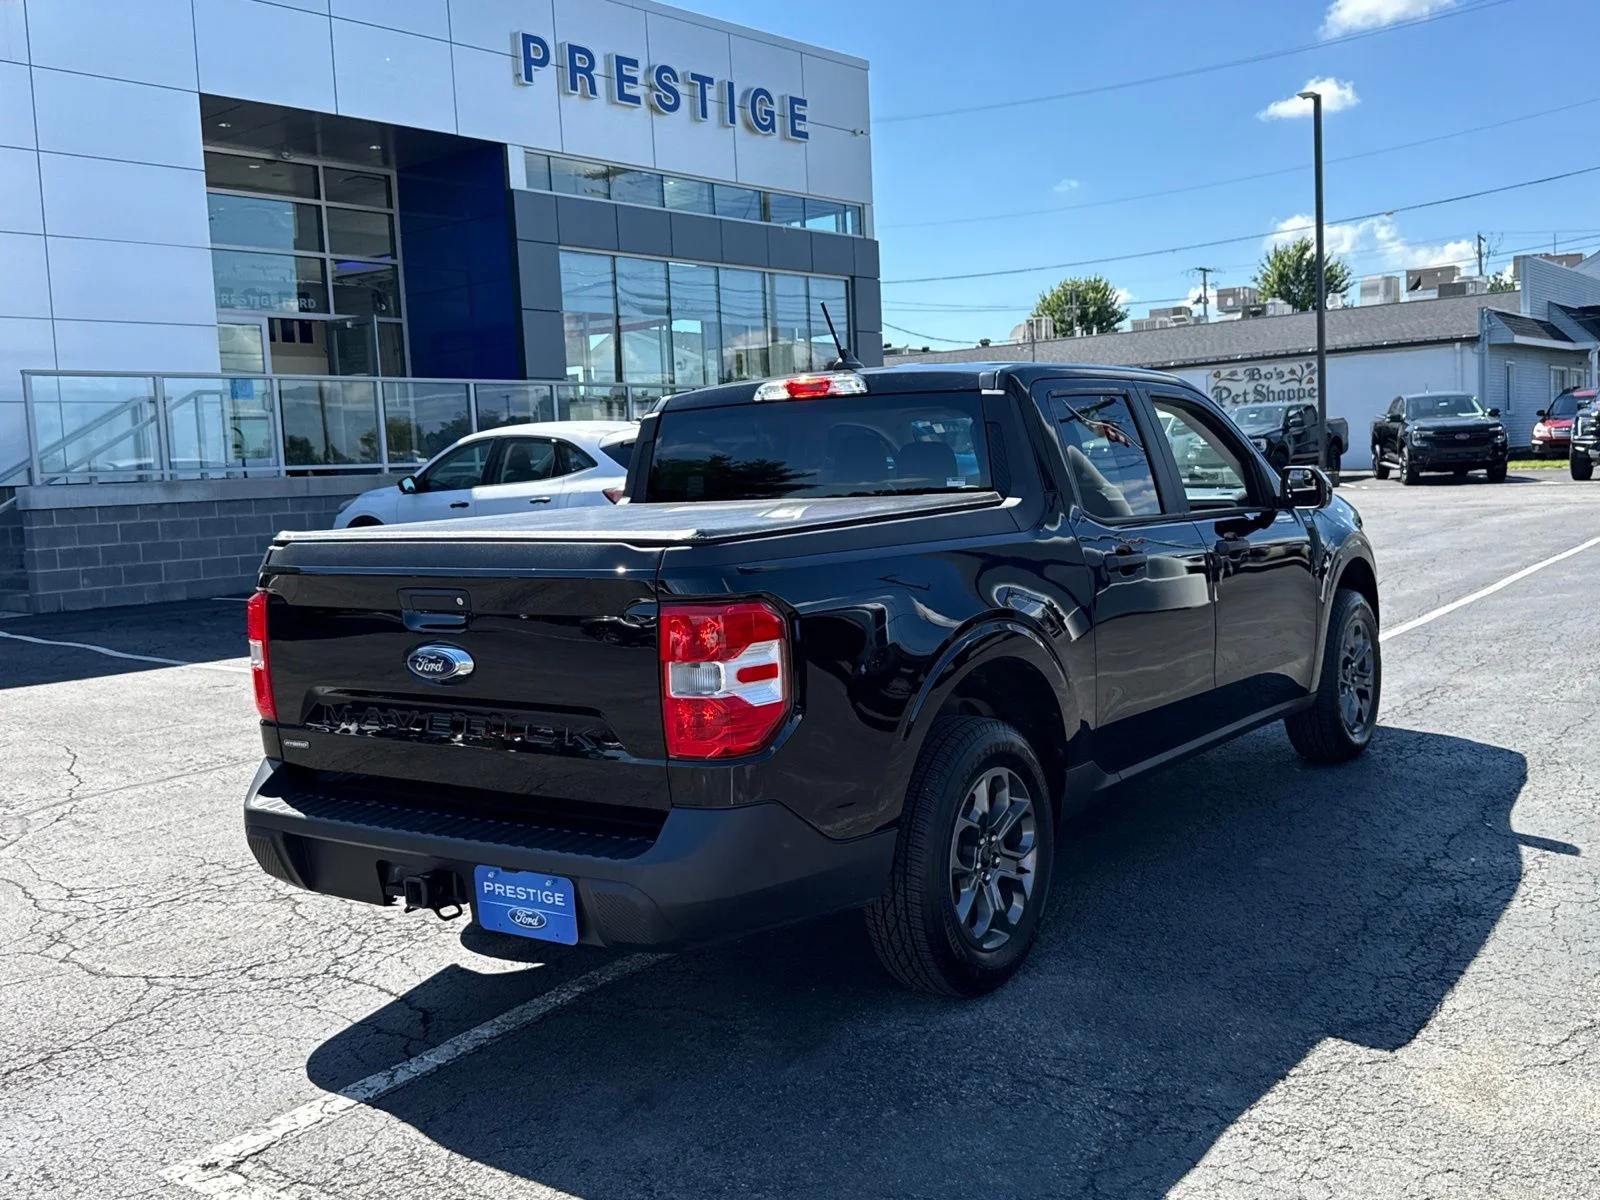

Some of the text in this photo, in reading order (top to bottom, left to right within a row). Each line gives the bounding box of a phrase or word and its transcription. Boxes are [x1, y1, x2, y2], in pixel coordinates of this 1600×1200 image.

[512, 31, 809, 142] PRESTIGE
[1243, 367, 1285, 381] Bo's
[1211, 384, 1317, 408] Pet Shoppe
[415, 654, 444, 672] Ford
[483, 881, 566, 907] PRESTIGE
[514, 909, 540, 927] Ford
